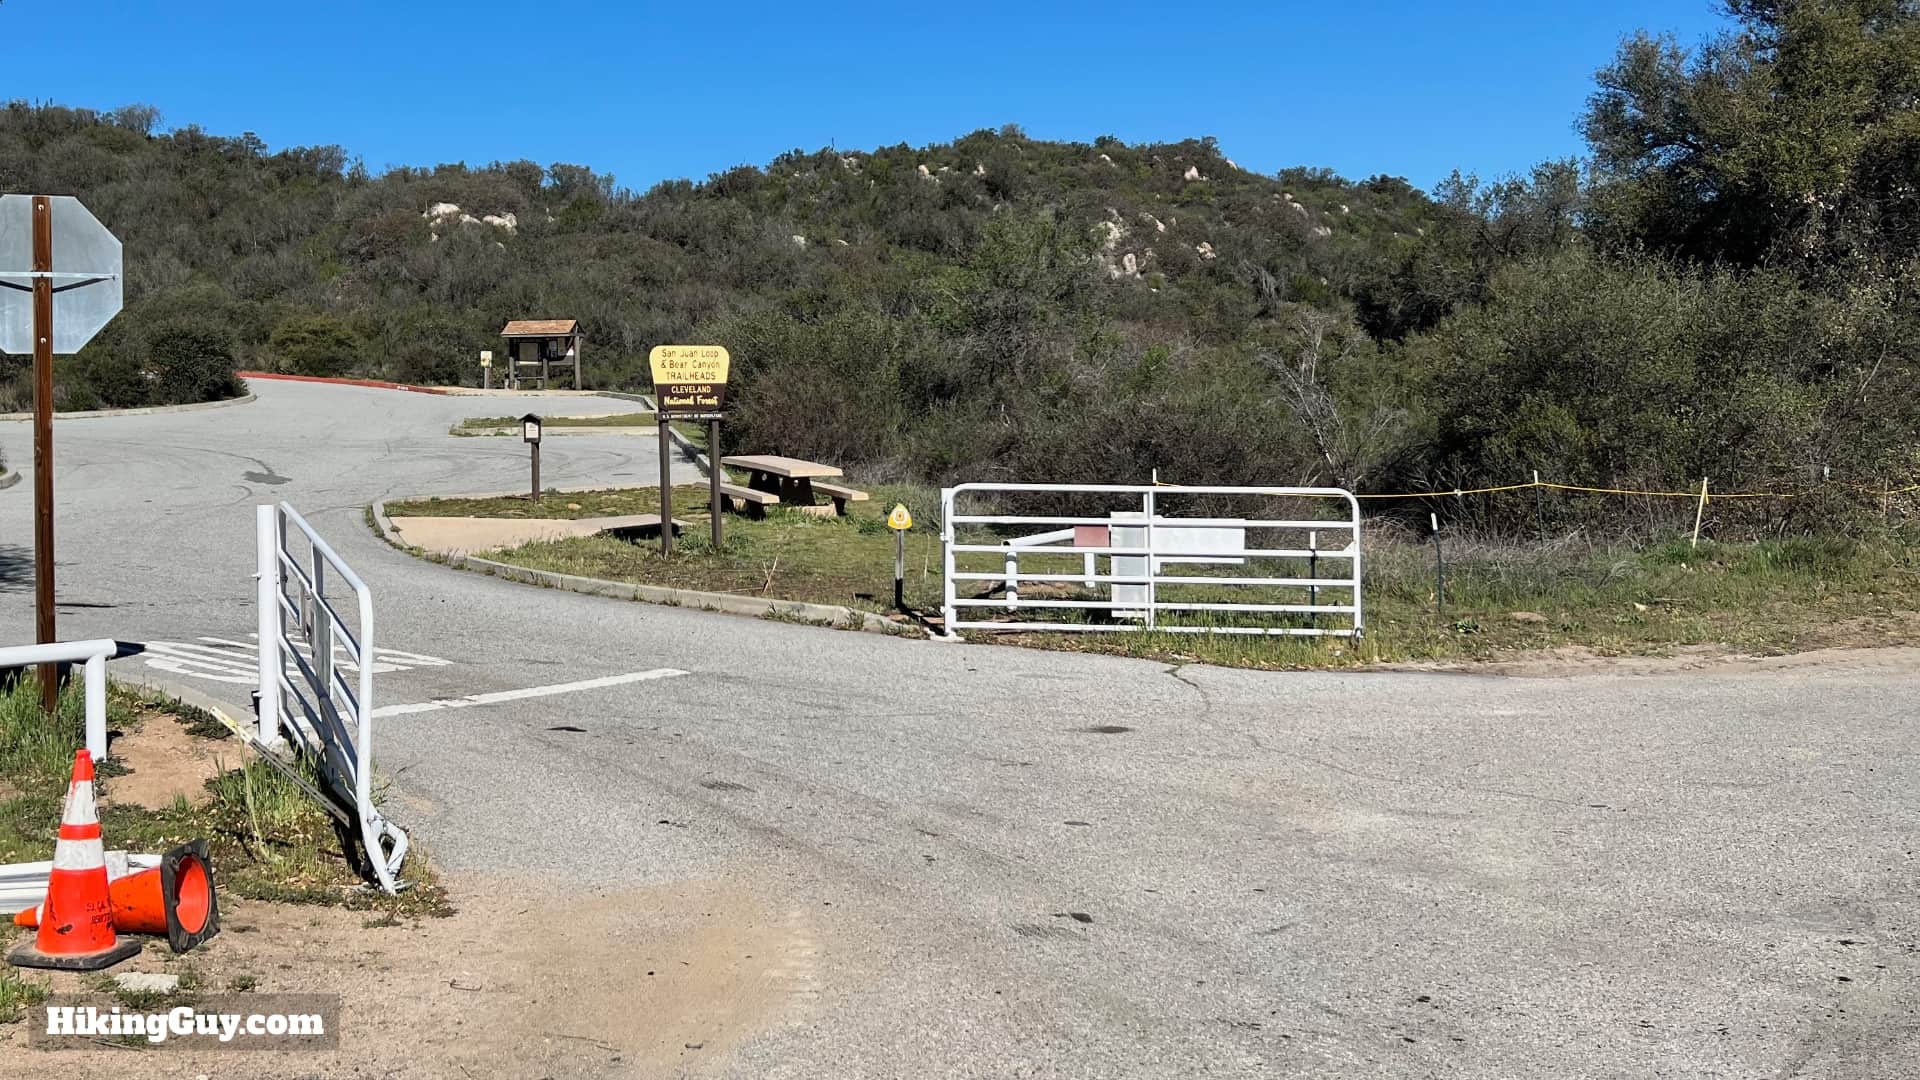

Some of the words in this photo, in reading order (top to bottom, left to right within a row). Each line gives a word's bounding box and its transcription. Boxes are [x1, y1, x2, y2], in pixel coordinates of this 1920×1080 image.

[662, 349, 676, 358] San
[680, 349, 698, 358] Juan
[701, 349, 719, 358] Loop
[660, 360, 667, 368] &
[669, 360, 688, 368] Bear
[692, 360, 720, 370] Canyon
[666, 372, 716, 380] TRAILHEADS
[671, 386, 711, 394] CLEVELAND
[663, 396, 694, 405] National
